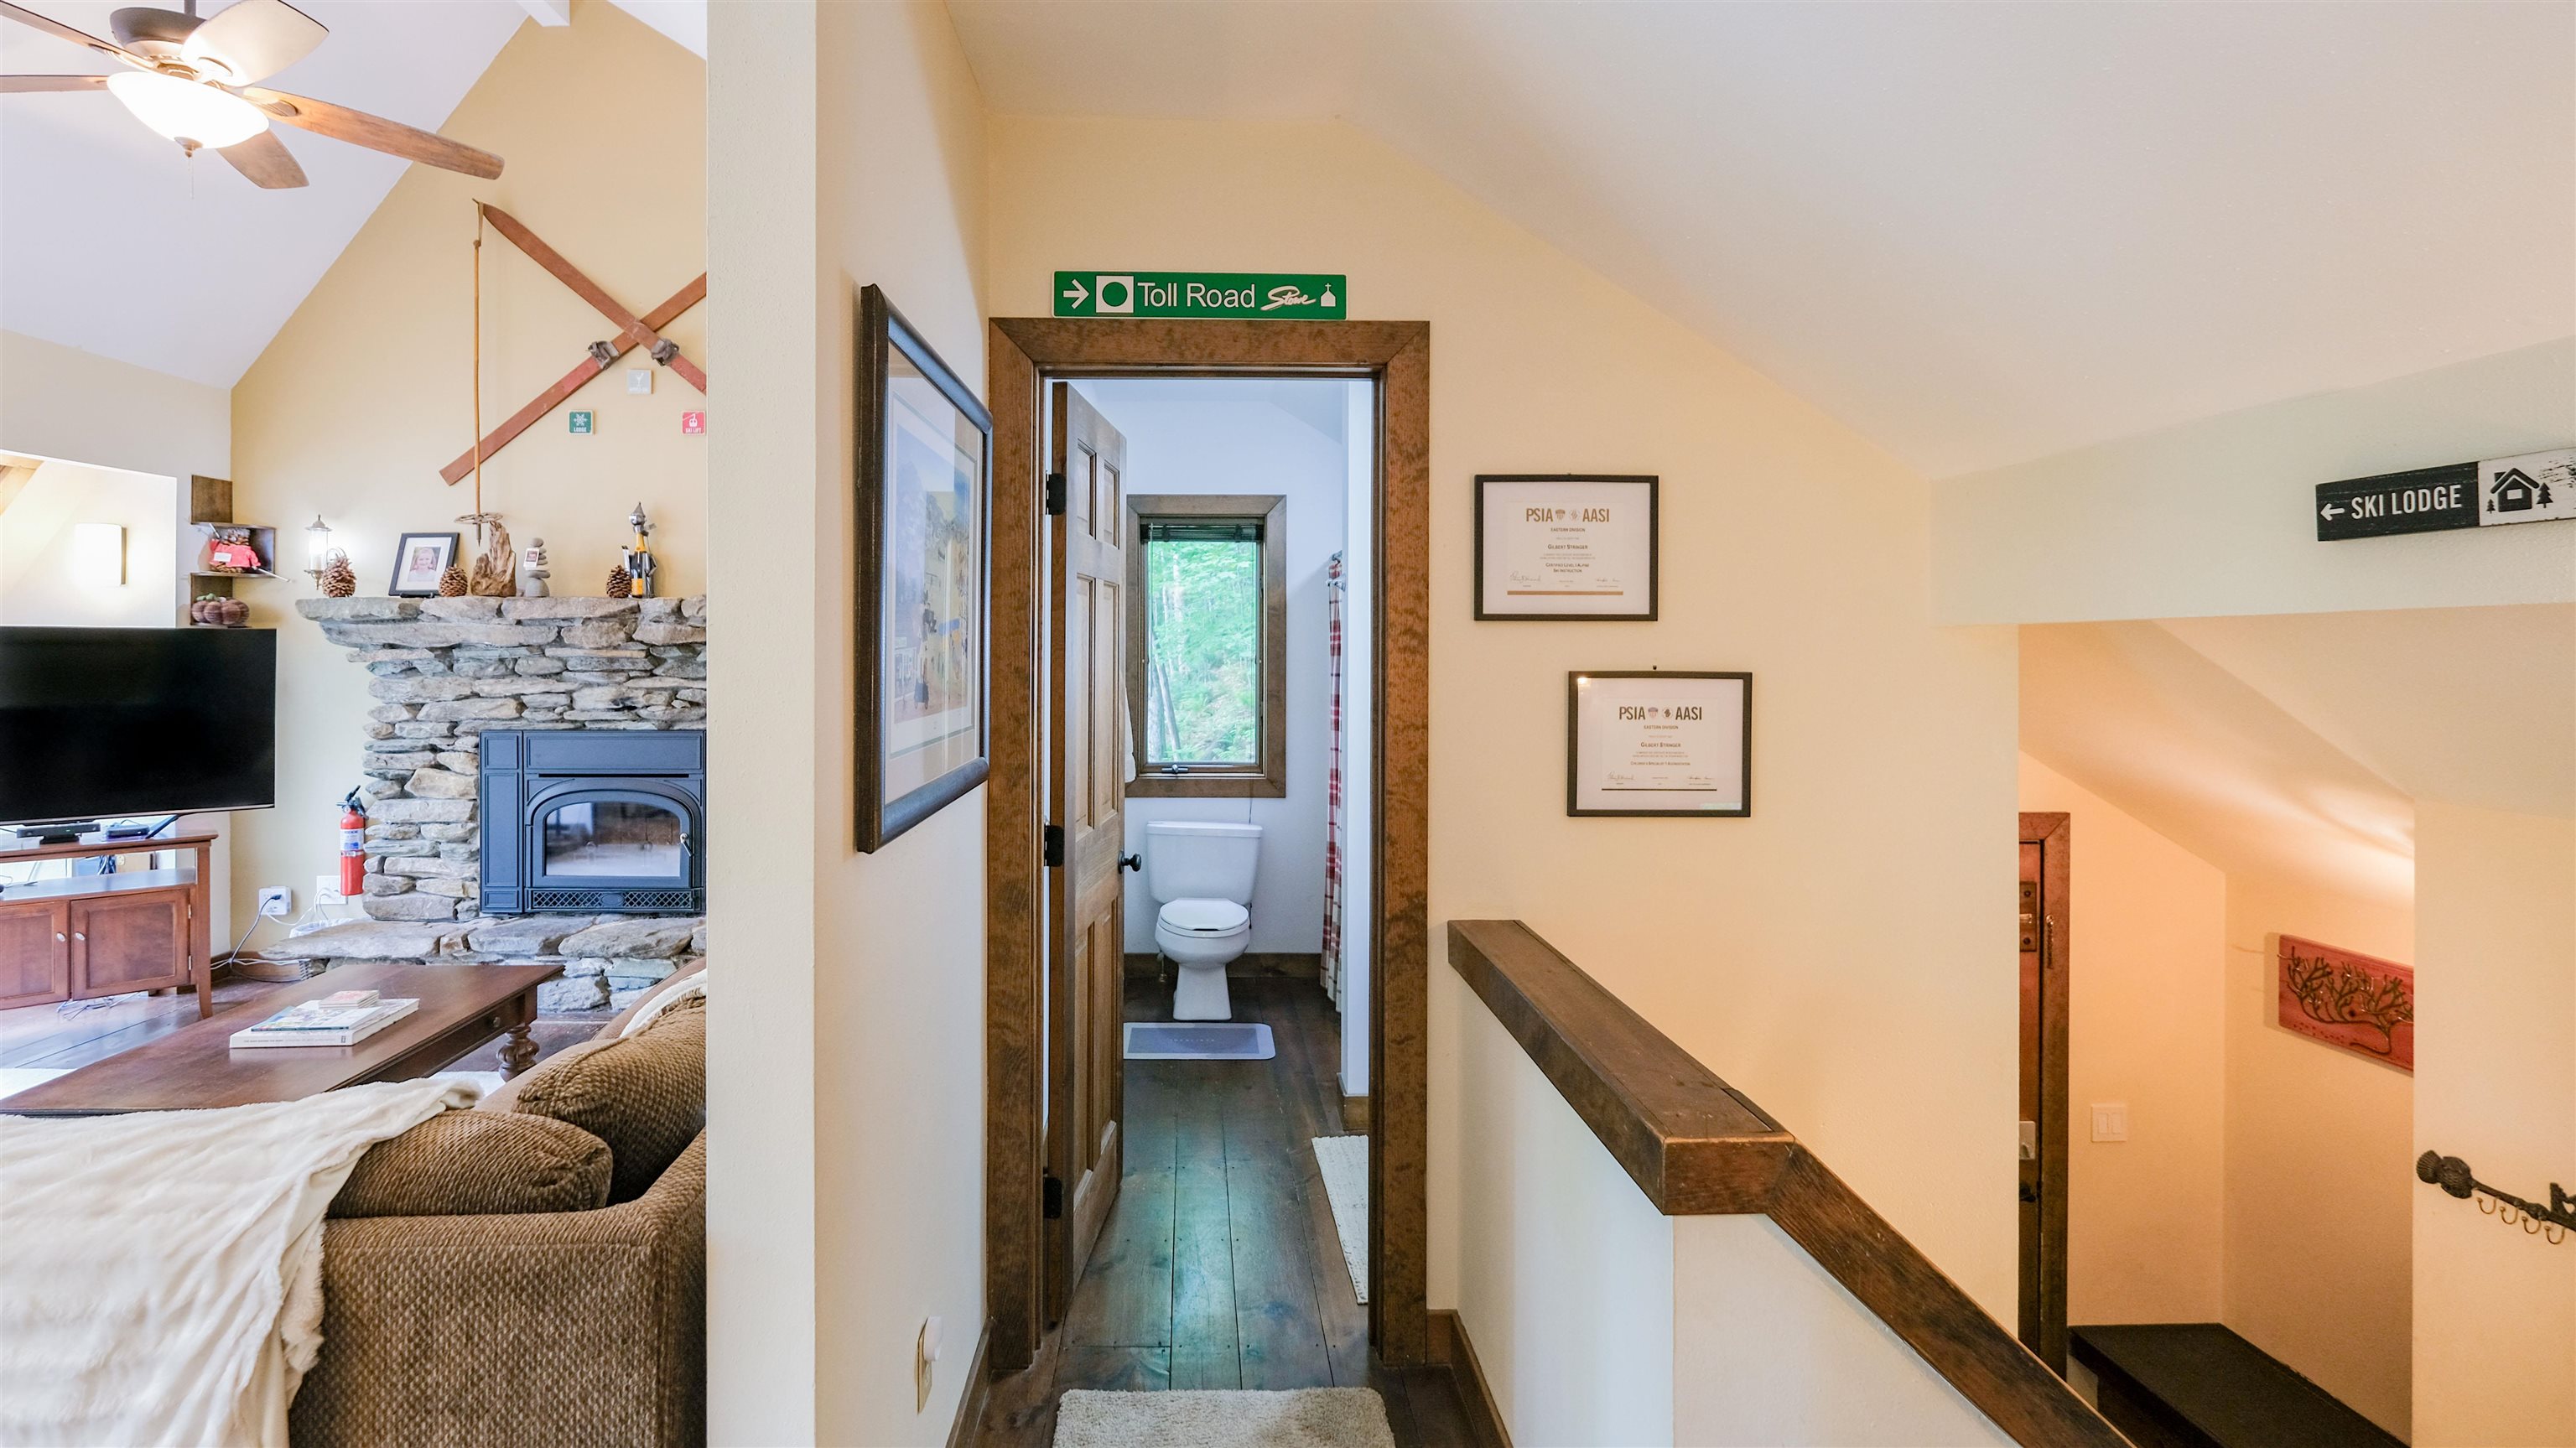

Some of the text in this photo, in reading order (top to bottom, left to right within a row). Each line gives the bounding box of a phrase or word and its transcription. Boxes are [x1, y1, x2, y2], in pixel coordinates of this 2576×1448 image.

[1137, 282, 1255, 308] Toll Road
[1260, 285, 1317, 310] Stowe
[2350, 484, 2462, 520] SKI LODGE
[1525, 508, 1554, 522] PSIA
[1582, 508, 1610, 522] AASI
[1618, 706, 1646, 720] PSIA
[1675, 706, 1702, 720] AASI
